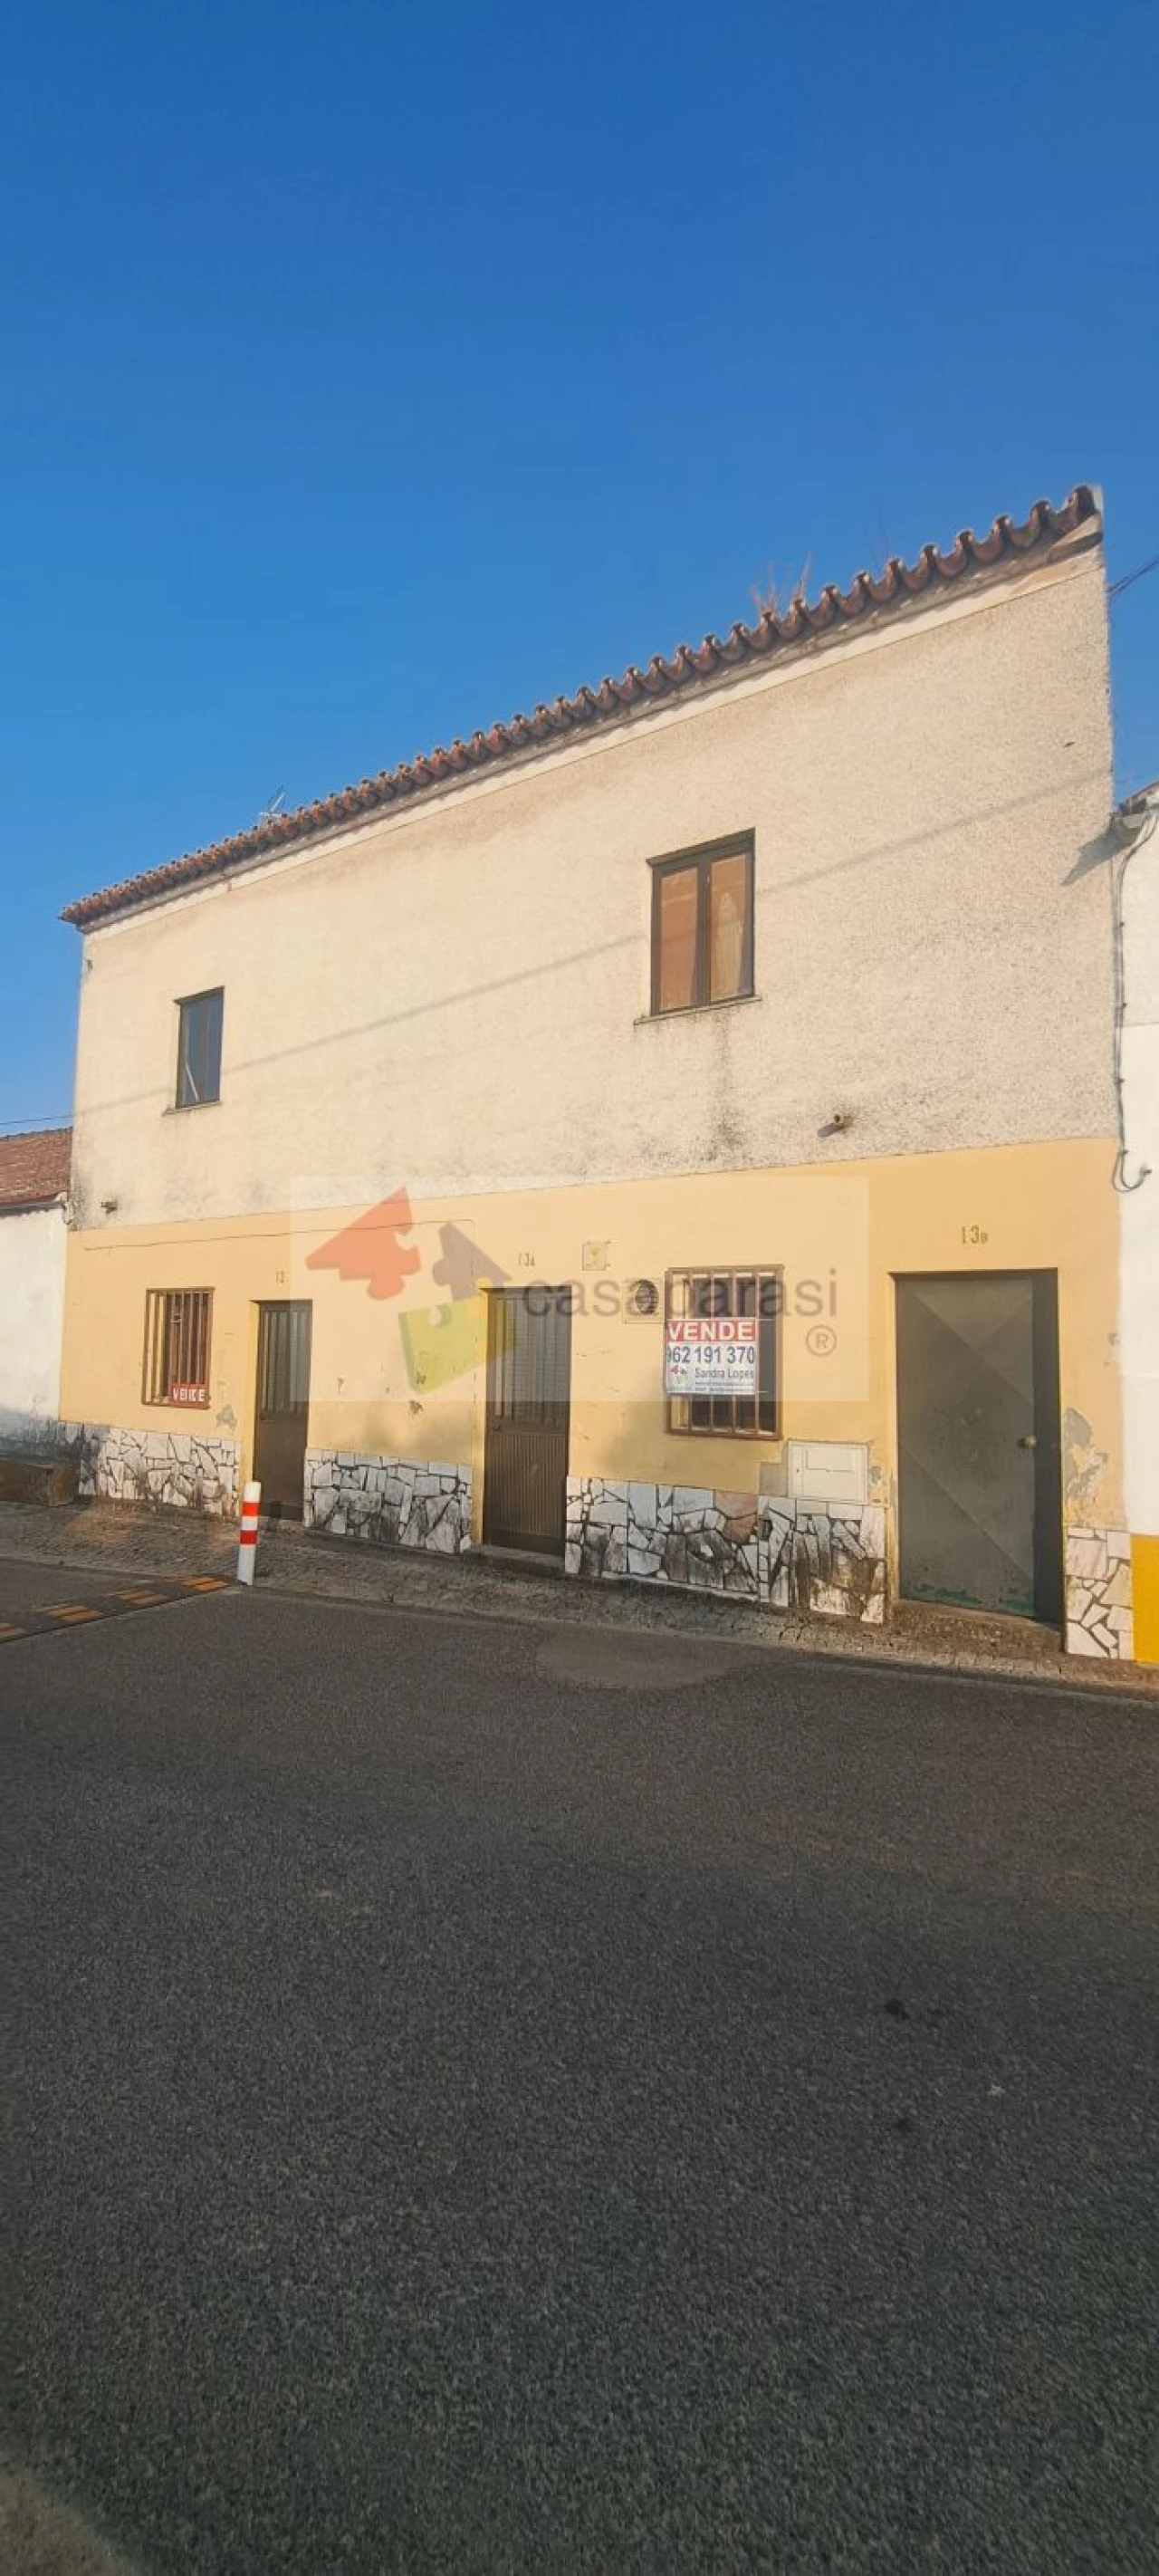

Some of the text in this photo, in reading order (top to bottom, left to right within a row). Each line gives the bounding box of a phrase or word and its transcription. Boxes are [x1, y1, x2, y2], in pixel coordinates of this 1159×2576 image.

[667, 1322, 755, 1341] VENDE
[695, 1346, 722, 1363] 191
[726, 1346, 755, 1363] 370
[694, 1368, 754, 1379] Sandra Lopes
